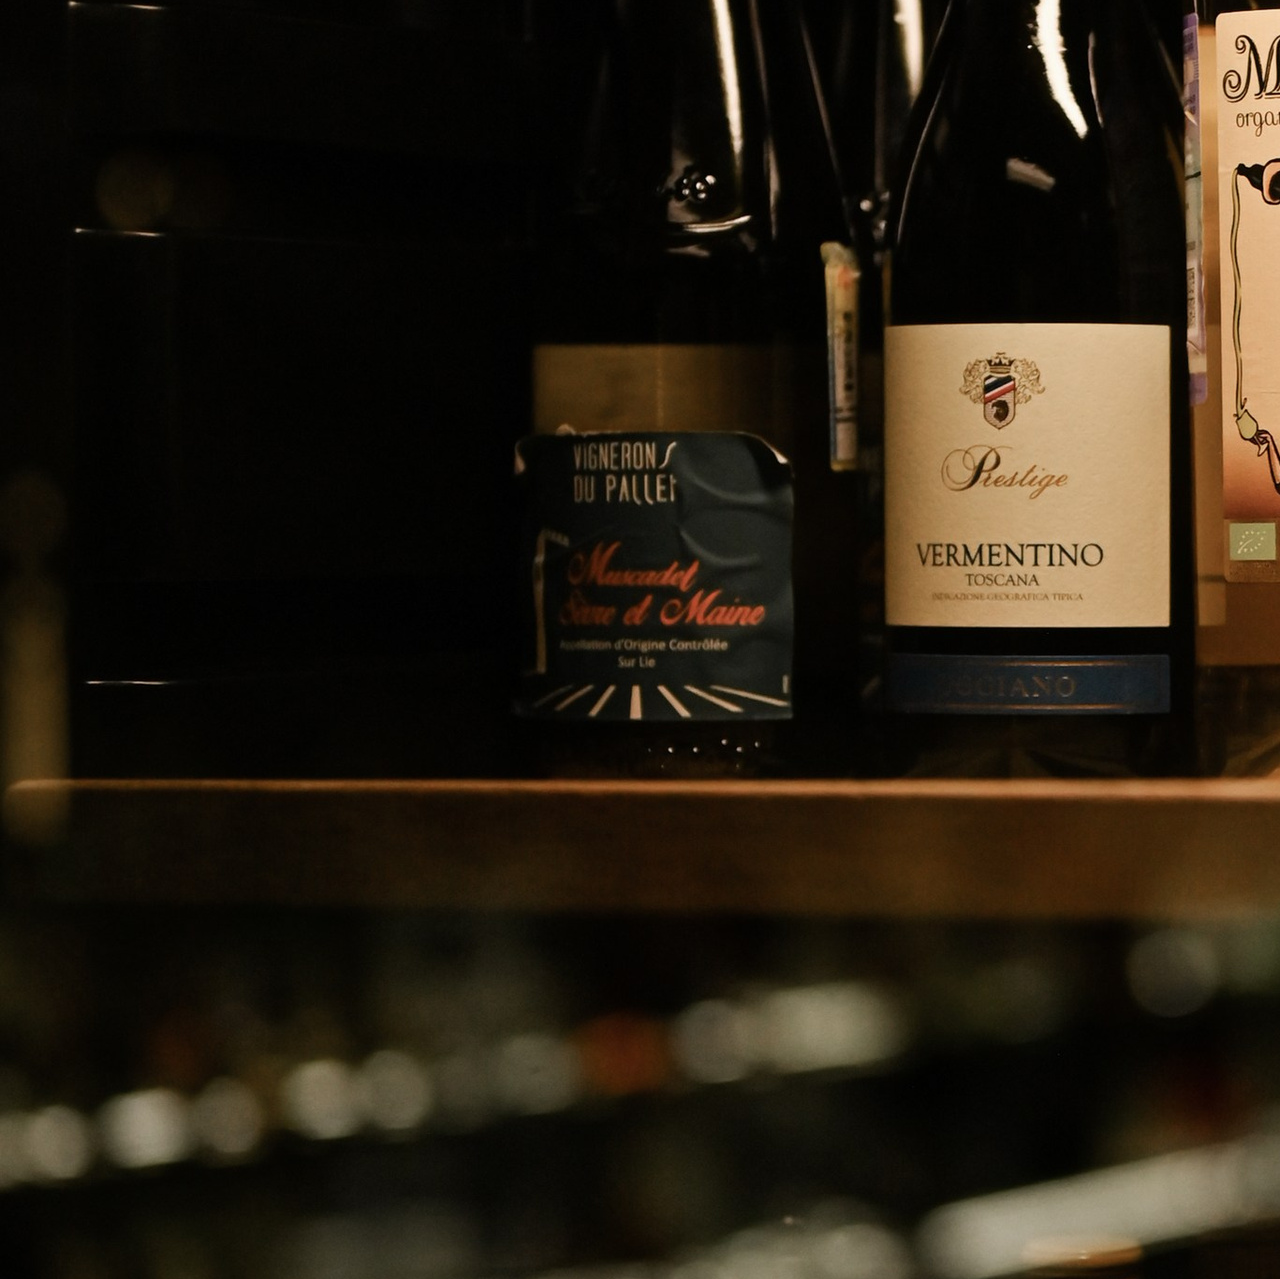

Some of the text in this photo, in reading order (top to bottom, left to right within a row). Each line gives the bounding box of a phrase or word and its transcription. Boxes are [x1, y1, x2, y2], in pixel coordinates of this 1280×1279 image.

[573, 441, 678, 471] VIGNERONS
[941, 444, 1069, 500] Prestige
[573, 474, 595, 504] DU
[917, 542, 1104, 568] VERMENTINO
[965, 573, 1040, 587] TOSCANA
[660, 587, 766, 626] Maine
[669, 638, 729, 651] Contrôlée
[618, 655, 656, 668] Sur Lie
